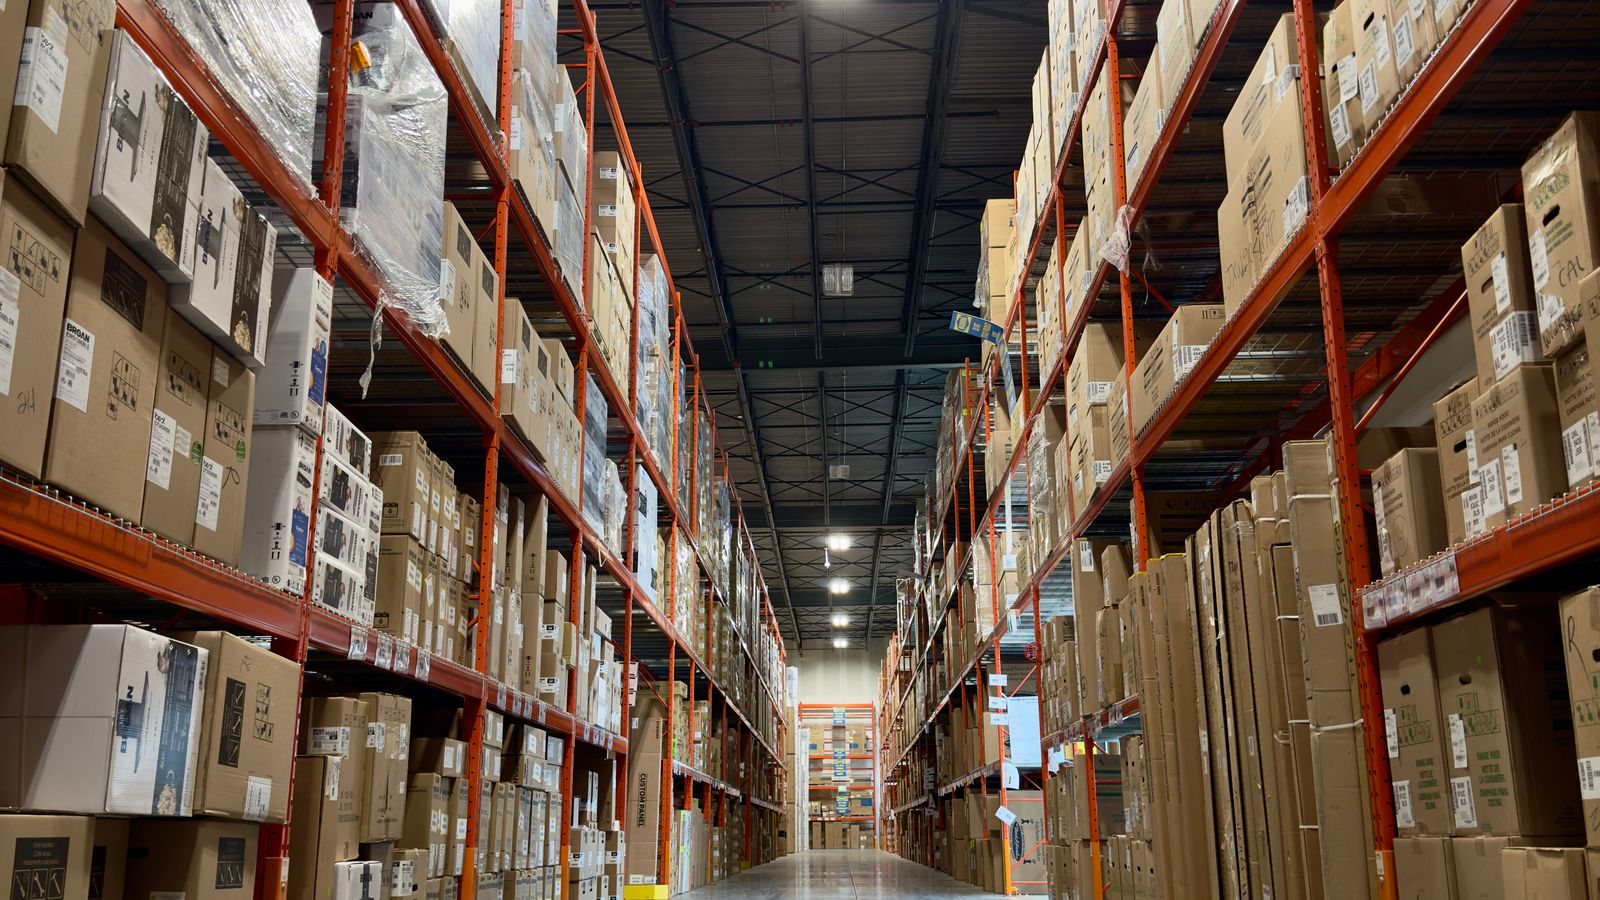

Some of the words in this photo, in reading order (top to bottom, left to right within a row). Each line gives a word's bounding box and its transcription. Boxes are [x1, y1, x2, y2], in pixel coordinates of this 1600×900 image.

[66, 323, 90, 343] BROAN
[639, 773, 647, 803] CUSTOM
[637, 803, 645, 828] PANEL
